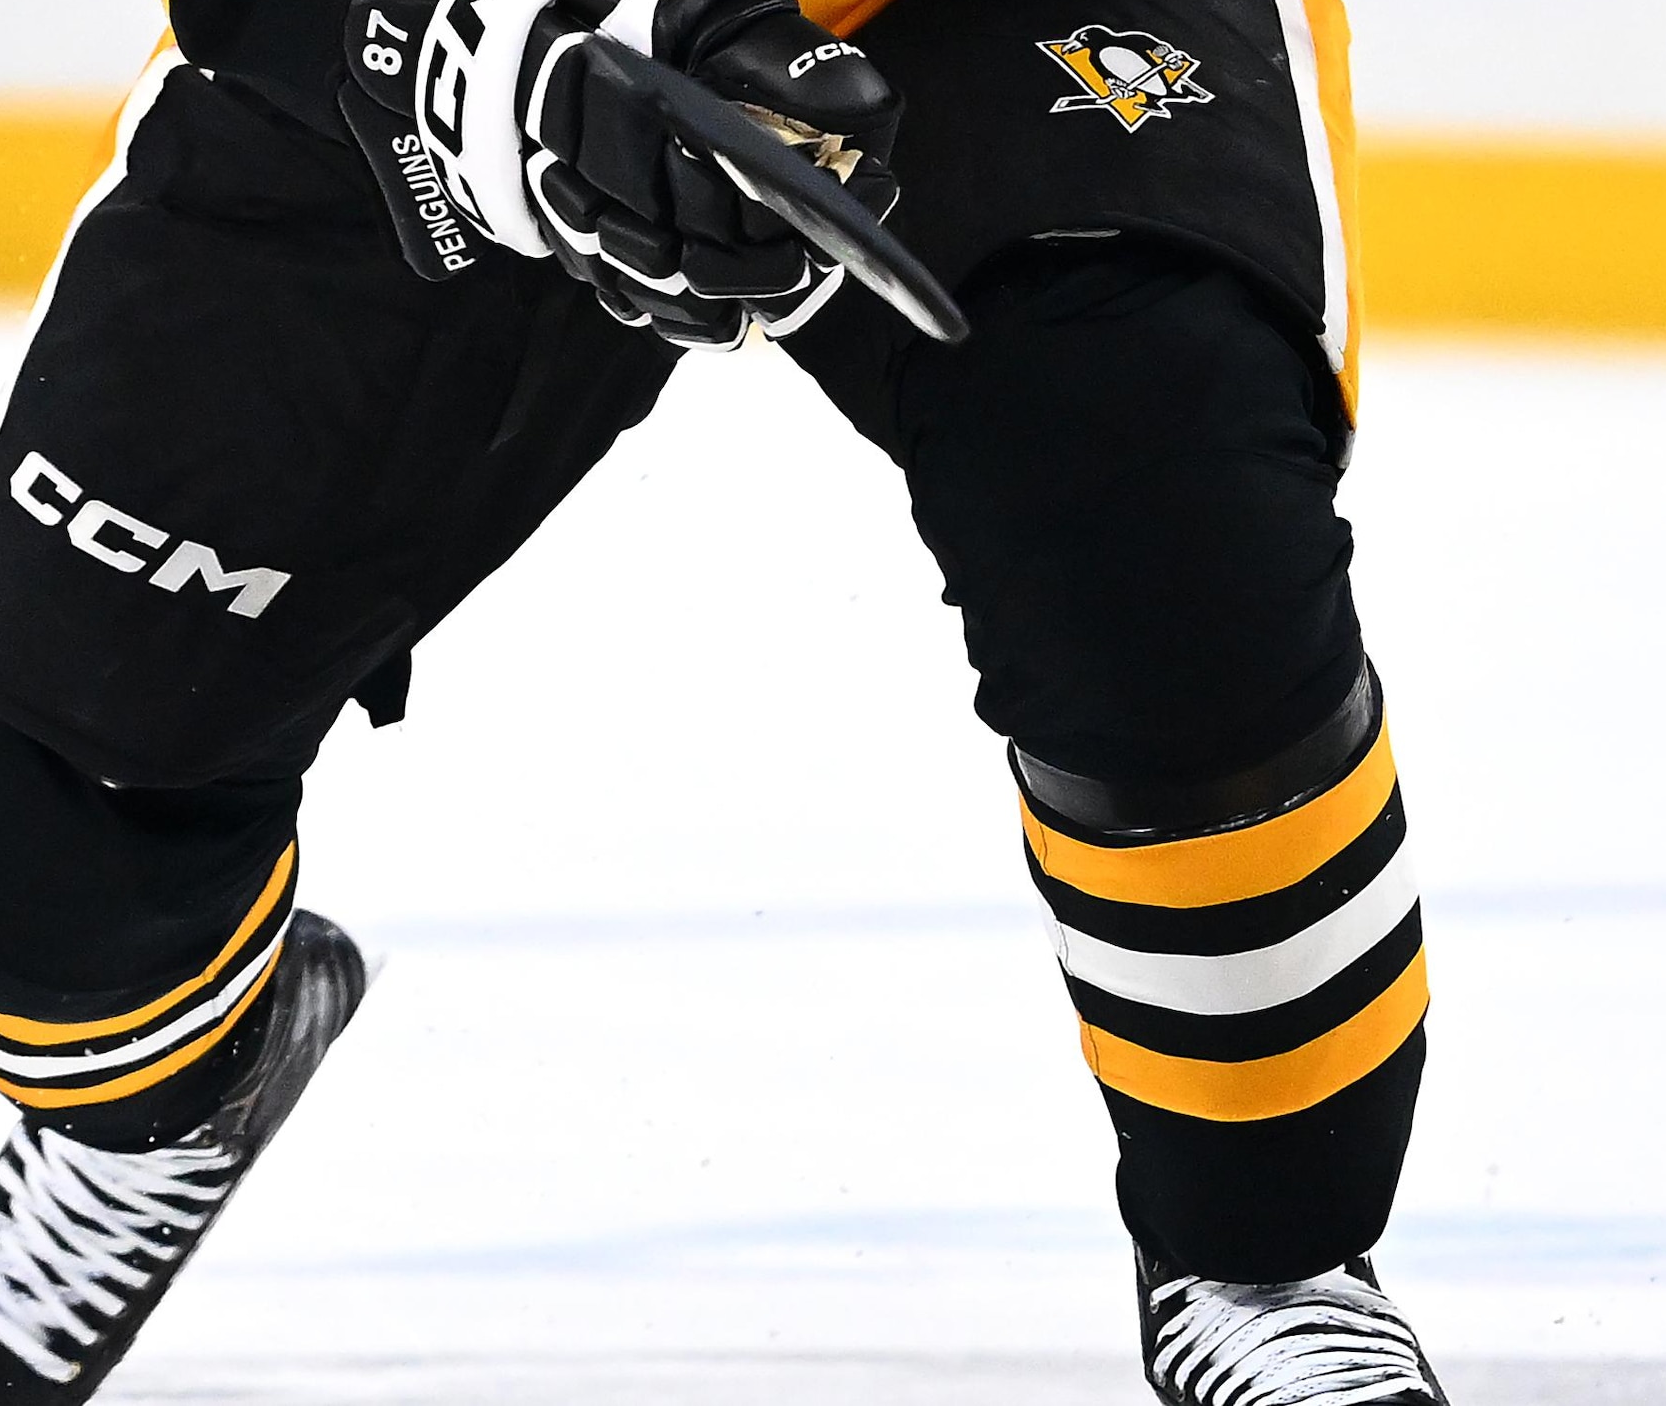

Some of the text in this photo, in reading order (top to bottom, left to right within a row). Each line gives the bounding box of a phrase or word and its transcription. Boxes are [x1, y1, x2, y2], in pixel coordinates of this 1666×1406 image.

[362, 7, 410, 78] 87
[391, 133, 478, 274] PENGUINS
[10, 450, 292, 619] CCM
